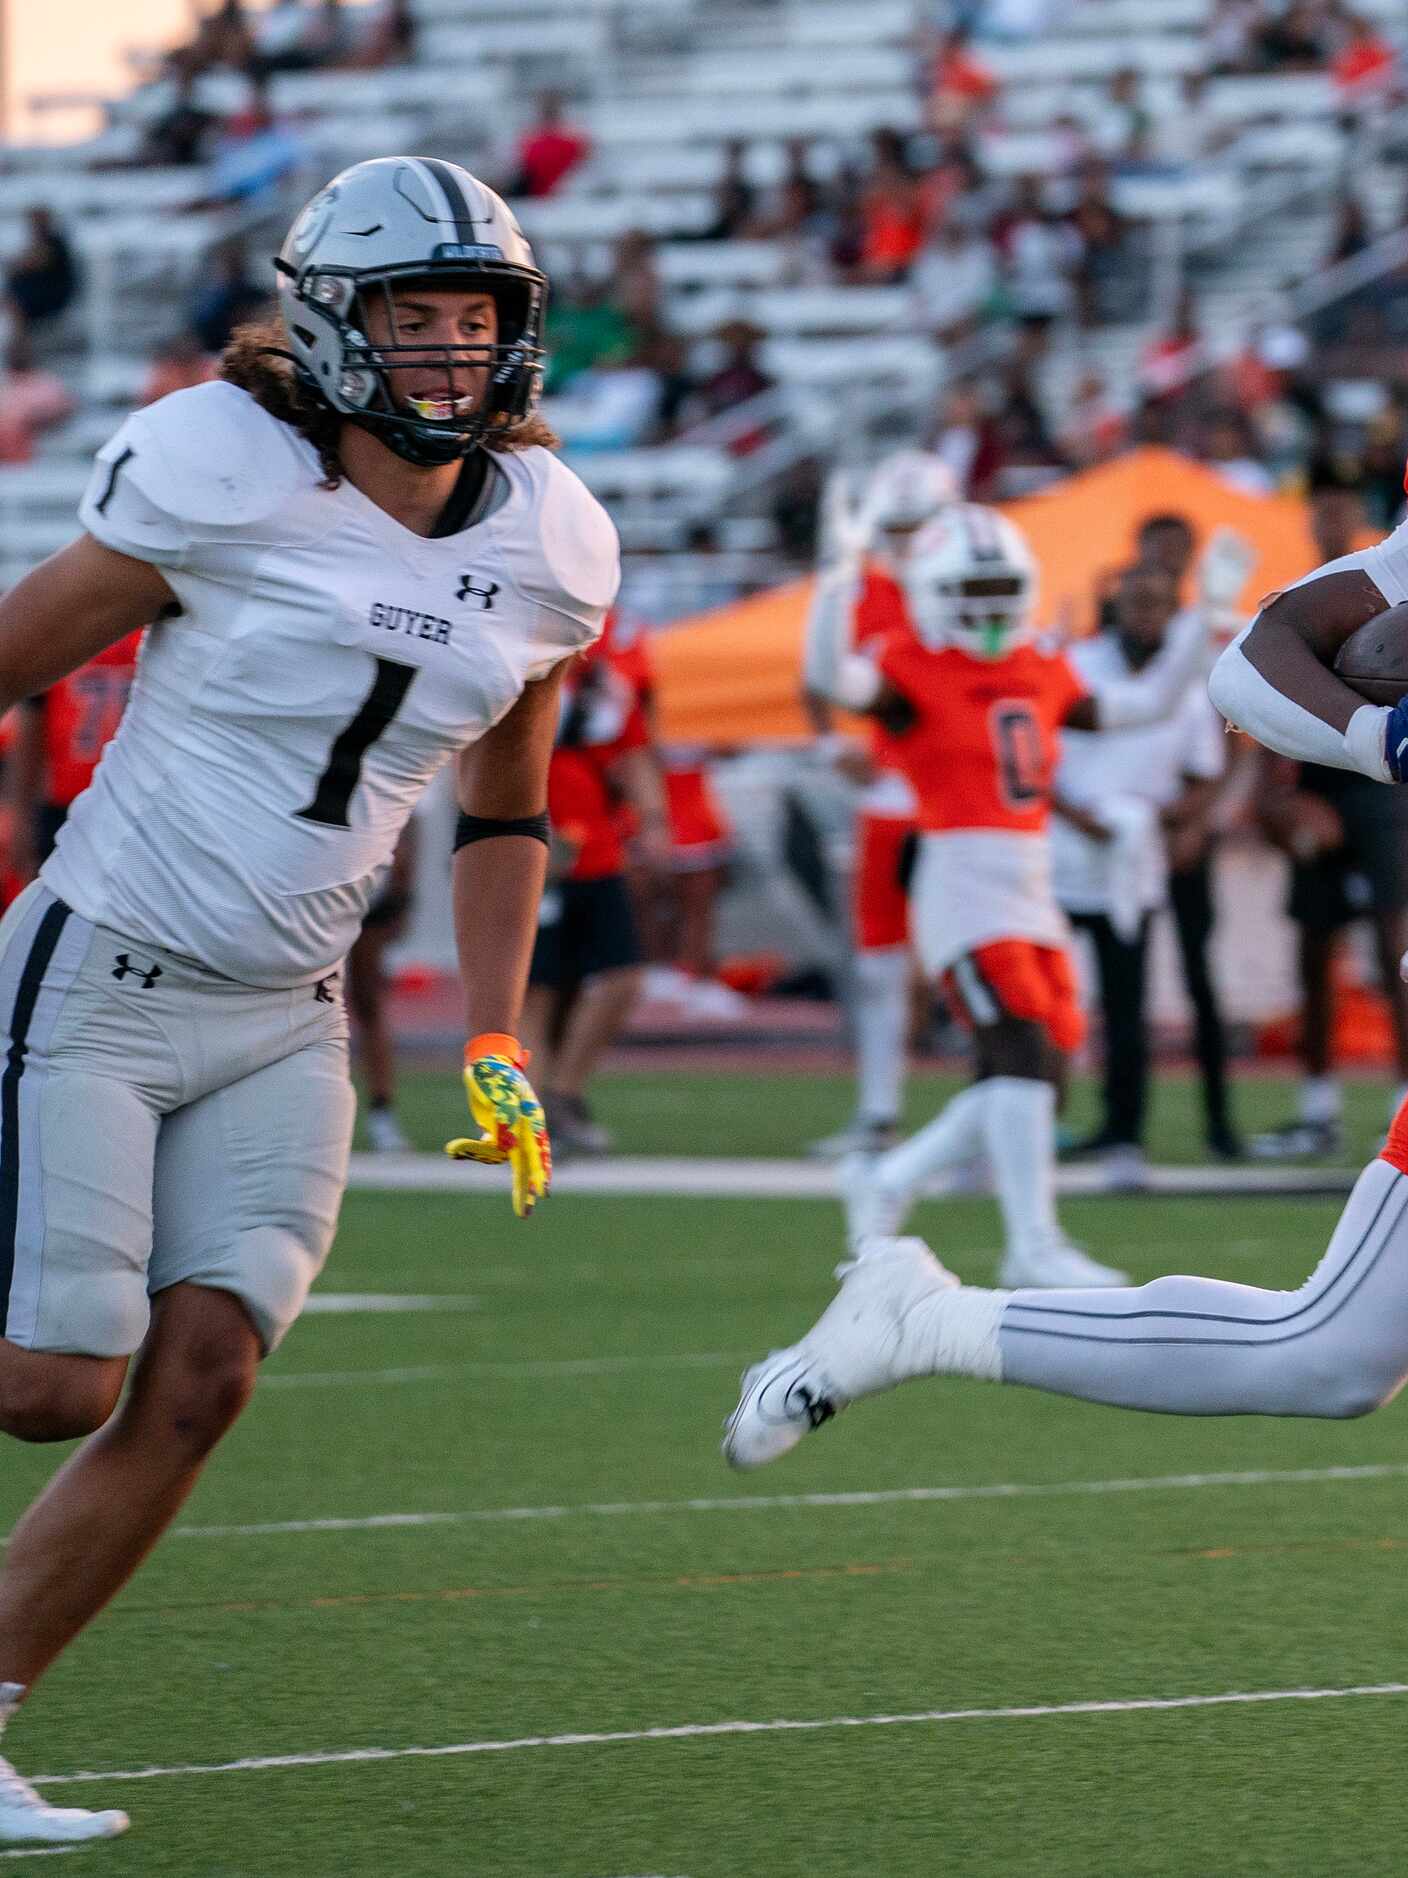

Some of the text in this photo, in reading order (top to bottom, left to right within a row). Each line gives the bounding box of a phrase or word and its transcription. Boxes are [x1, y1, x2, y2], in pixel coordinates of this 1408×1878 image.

[95, 446, 138, 520] 1
[369, 602, 453, 646] GUYER
[292, 655, 420, 828] 1
